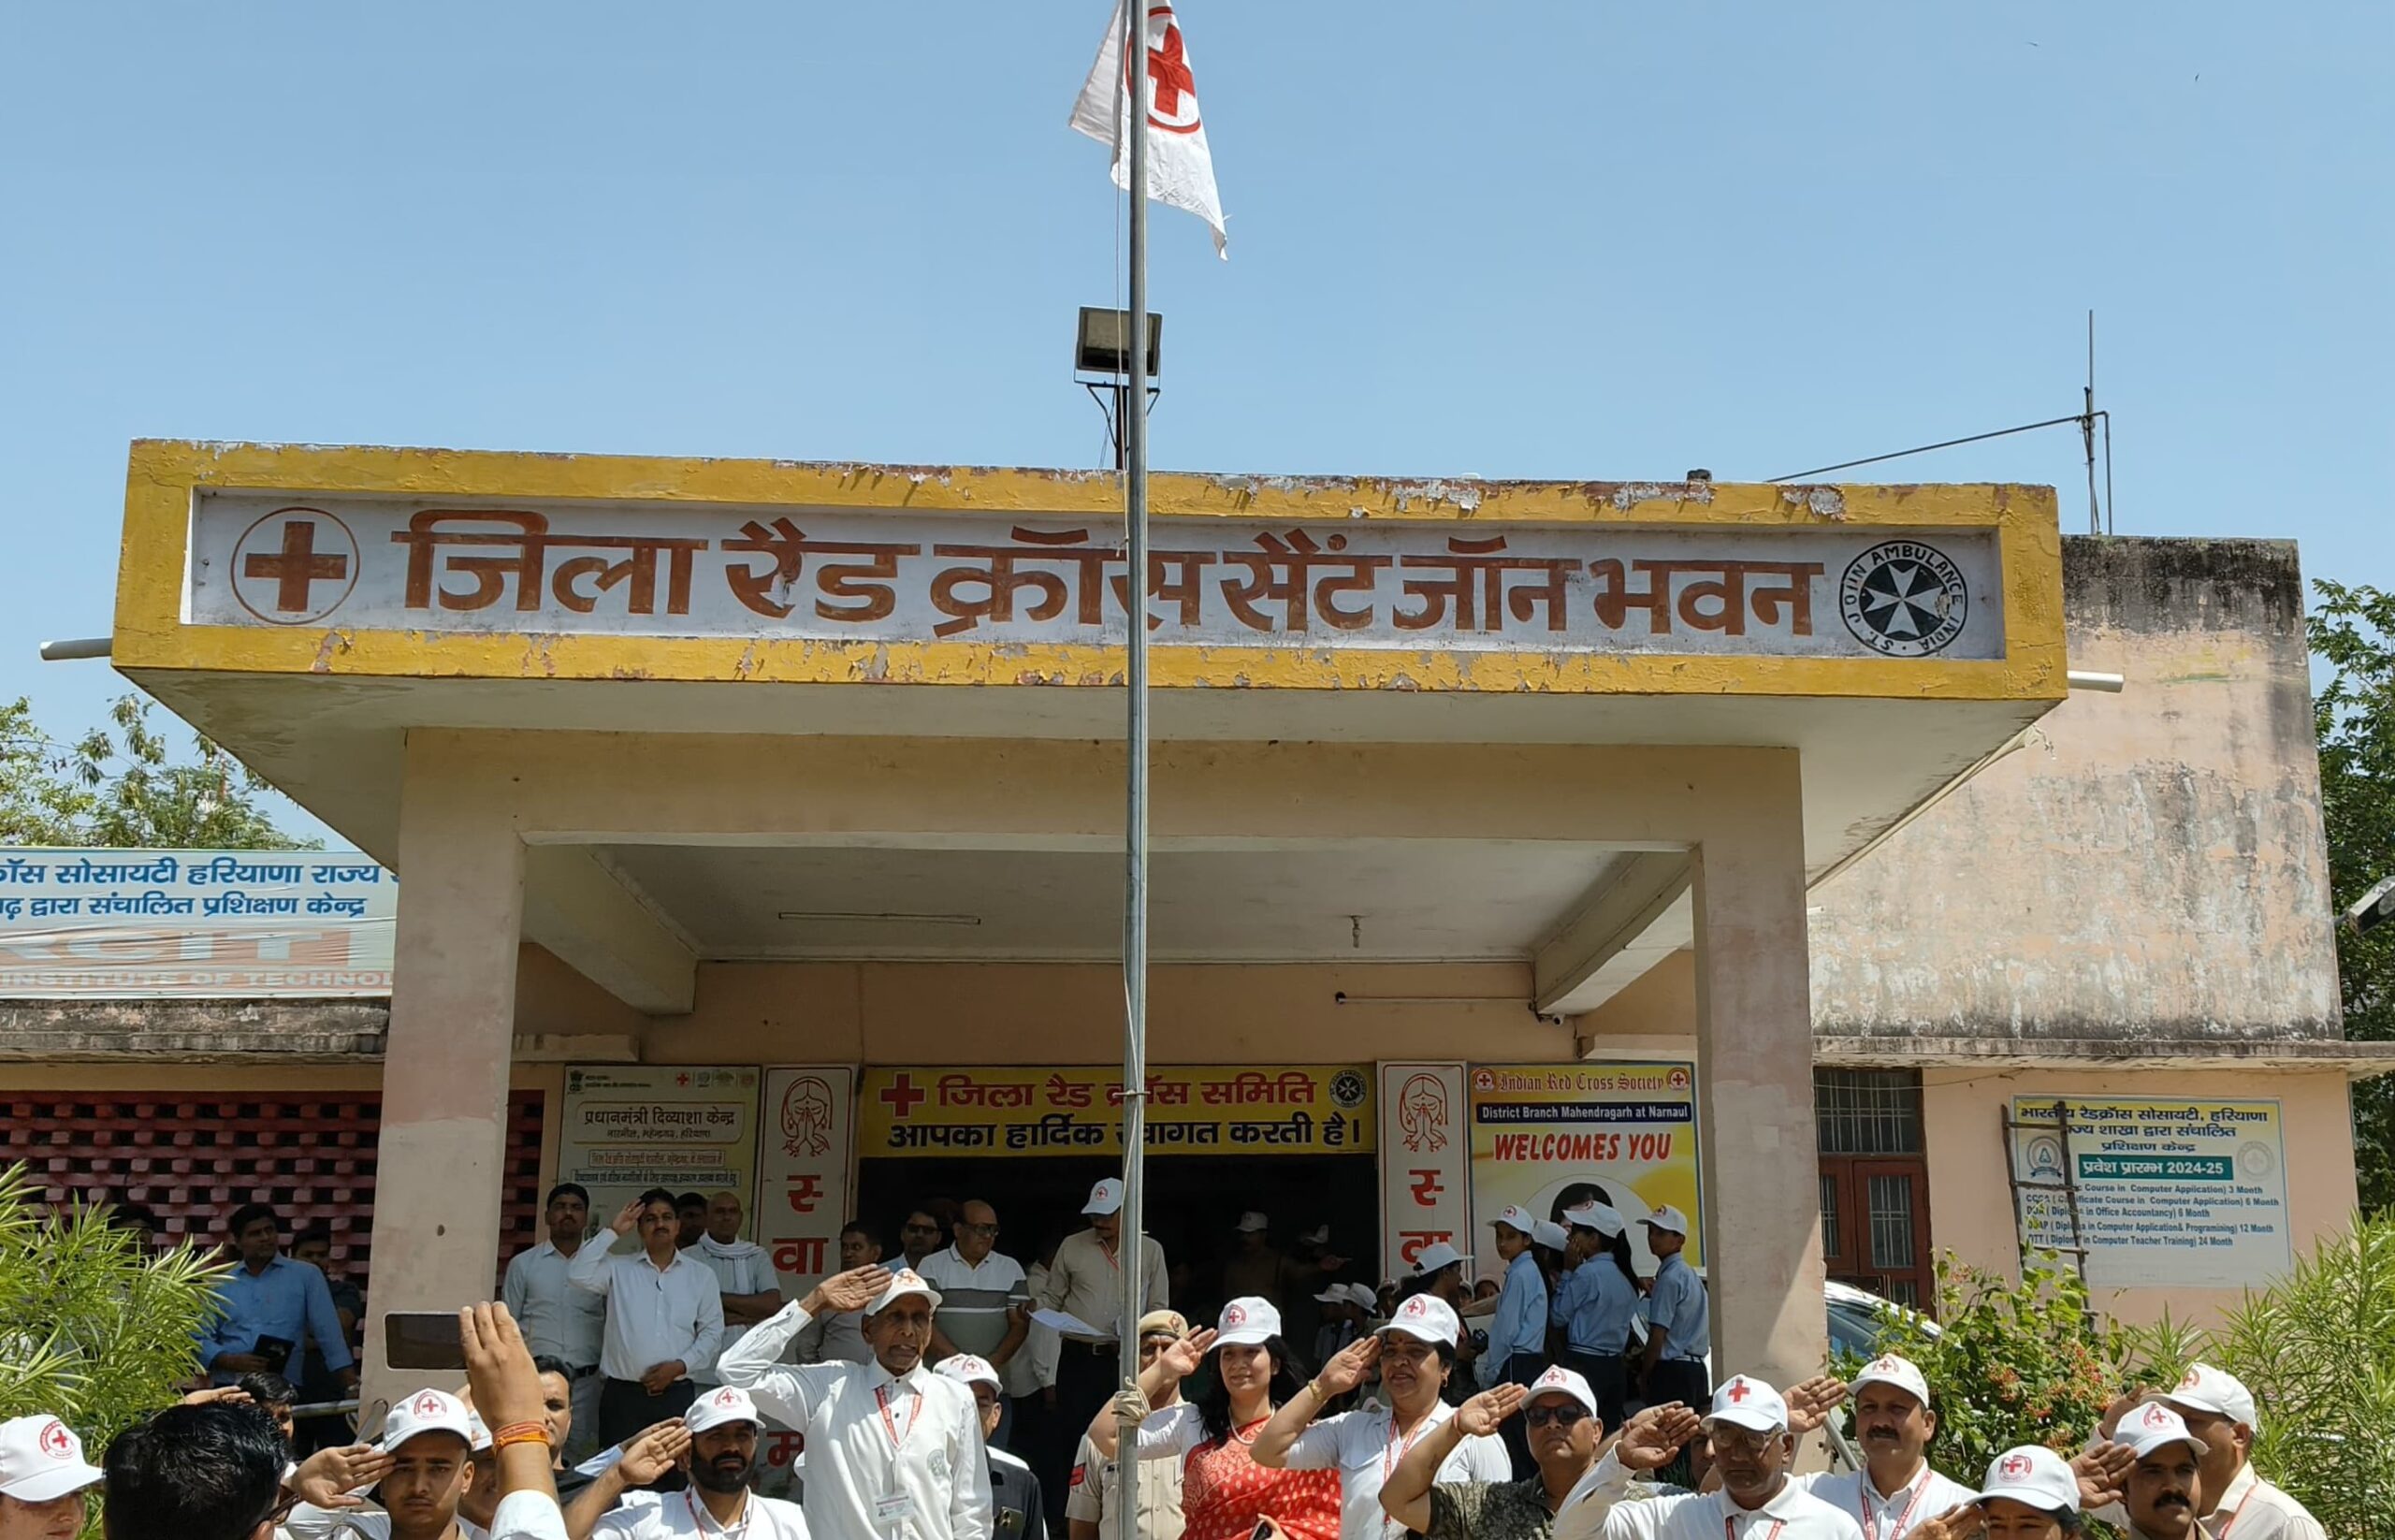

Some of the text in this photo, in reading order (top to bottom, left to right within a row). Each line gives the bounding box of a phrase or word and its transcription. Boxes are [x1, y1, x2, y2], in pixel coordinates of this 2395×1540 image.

[391, 509, 708, 616] जिला
[721, 516, 921, 623] रैड
[930, 526, 1216, 639] क्रॉस
[1393, 535, 1583, 632] जॉन
[1590, 558, 1823, 636] भवन
[1871, 545, 1963, 605] AMBULANCE
[1918, 616, 1960, 650] INDIA
[55, 857, 180, 883] सोसायटी
[187, 856, 304, 884] हरियाणा
[311, 864, 383, 884] राज्य
[30, 897, 81, 916] द्वारा
[88, 891, 196, 914] संचालित
[202, 891, 299, 917] प्रशिक्षण
[306, 892, 368, 918] केन्द्र
[187, 972, 232, 986] OF
[1499, 1071, 1663, 1092] Indian Red Cross Society
[937, 1072, 1035, 1107] जिला
[1046, 1073, 1096, 1109] रैड
[1200, 1073, 1317, 1106] समिति
[584, 1107, 647, 1125] प्रधानमंत्री
[706, 1107, 735, 1125] केन्द्र
[1482, 1105, 1688, 1121] District Branch Mahendragarh at Narnaul
[2210, 1108, 2268, 1122] हरियाणा
[887, 1123, 996, 1149] आपका
[1006, 1113, 1107, 1149] हार्दिक
[1229, 1111, 1316, 1145] करती
[2099, 1125, 2138, 1136] शाखा
[2143, 1126, 2171, 1137] द्वारा
[2176, 1123, 2236, 1138] संचालित
[1494, 1133, 1671, 1161] WELCOMES YOU
[2101, 1140, 2156, 1152] प्रशिक्षण
[2083, 1157, 2116, 1174] प्रवेश
[2167, 1162, 2224, 1175] 2024-25
[2084, 1184, 2114, 1192] Course
[2130, 1184, 2172, 1194] Computer
[2228, 1185, 2234, 1194] 3
[2236, 1185, 2263, 1194] Month
[2105, 1196, 2135, 1204] Course
[2137, 1196, 2145, 1204] in
[2150, 1197, 2190, 1206] Computer
[2253, 1198, 2279, 1206] Month
[2086, 1207, 2094, 1215] in
[2096, 1207, 2120, 1215] Office
[2185, 1208, 2210, 1217] Month
[2097, 1221, 2133, 1232] Computer
[2240, 1224, 2249, 1232] 12
[2250, 1224, 2273, 1232] Month
[2092, 1235, 2128, 1245] Computer
[2130, 1236, 2161, 1245] Teacher
[2199, 1237, 2208, 1245] 24
[2210, 1237, 2233, 1246] Month
